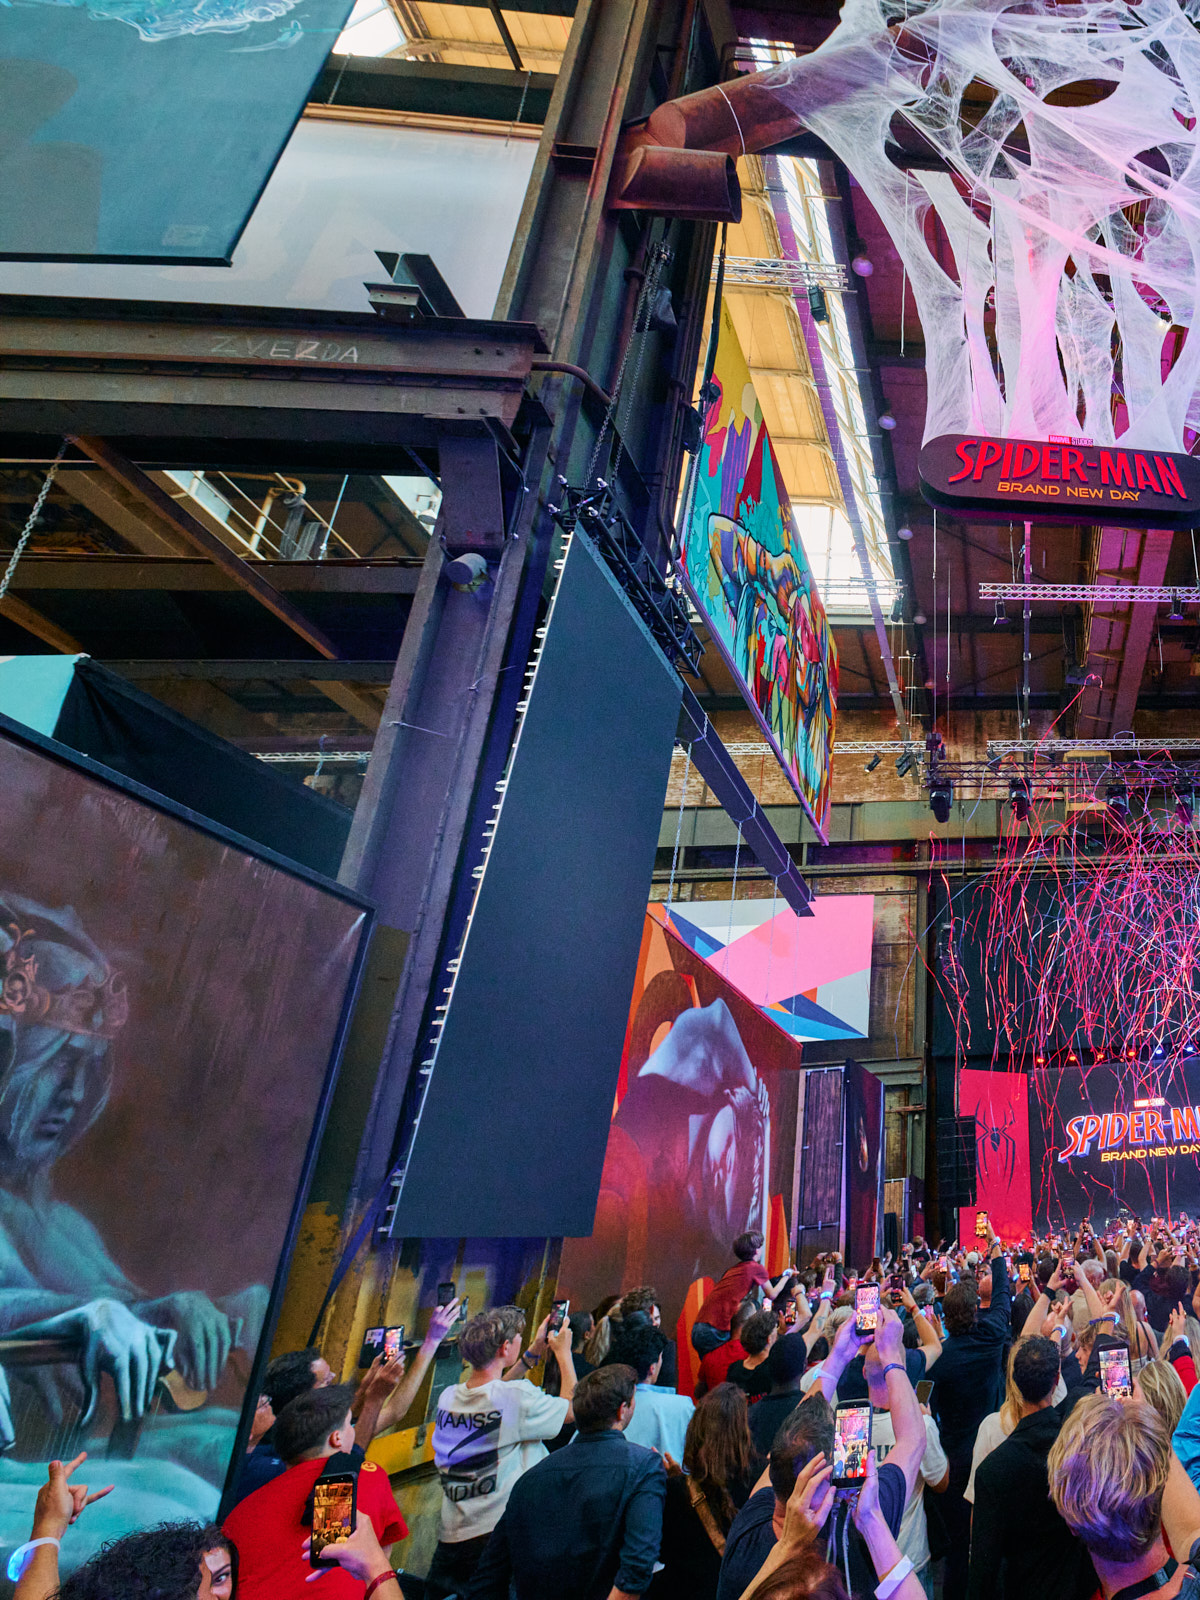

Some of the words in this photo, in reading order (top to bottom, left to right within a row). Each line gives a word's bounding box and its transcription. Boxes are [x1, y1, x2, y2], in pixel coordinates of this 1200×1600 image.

[210, 334, 359, 364] ZVEZDA
[948, 439, 1188, 501] SPIDER-MAN
[997, 482, 1061, 497] BRAND
[1066, 487, 1104, 499] NEW
[1110, 490, 1141, 502] DAY
[1101, 1149, 1148, 1163] BRAND
[1149, 1145, 1178, 1158] NEW
